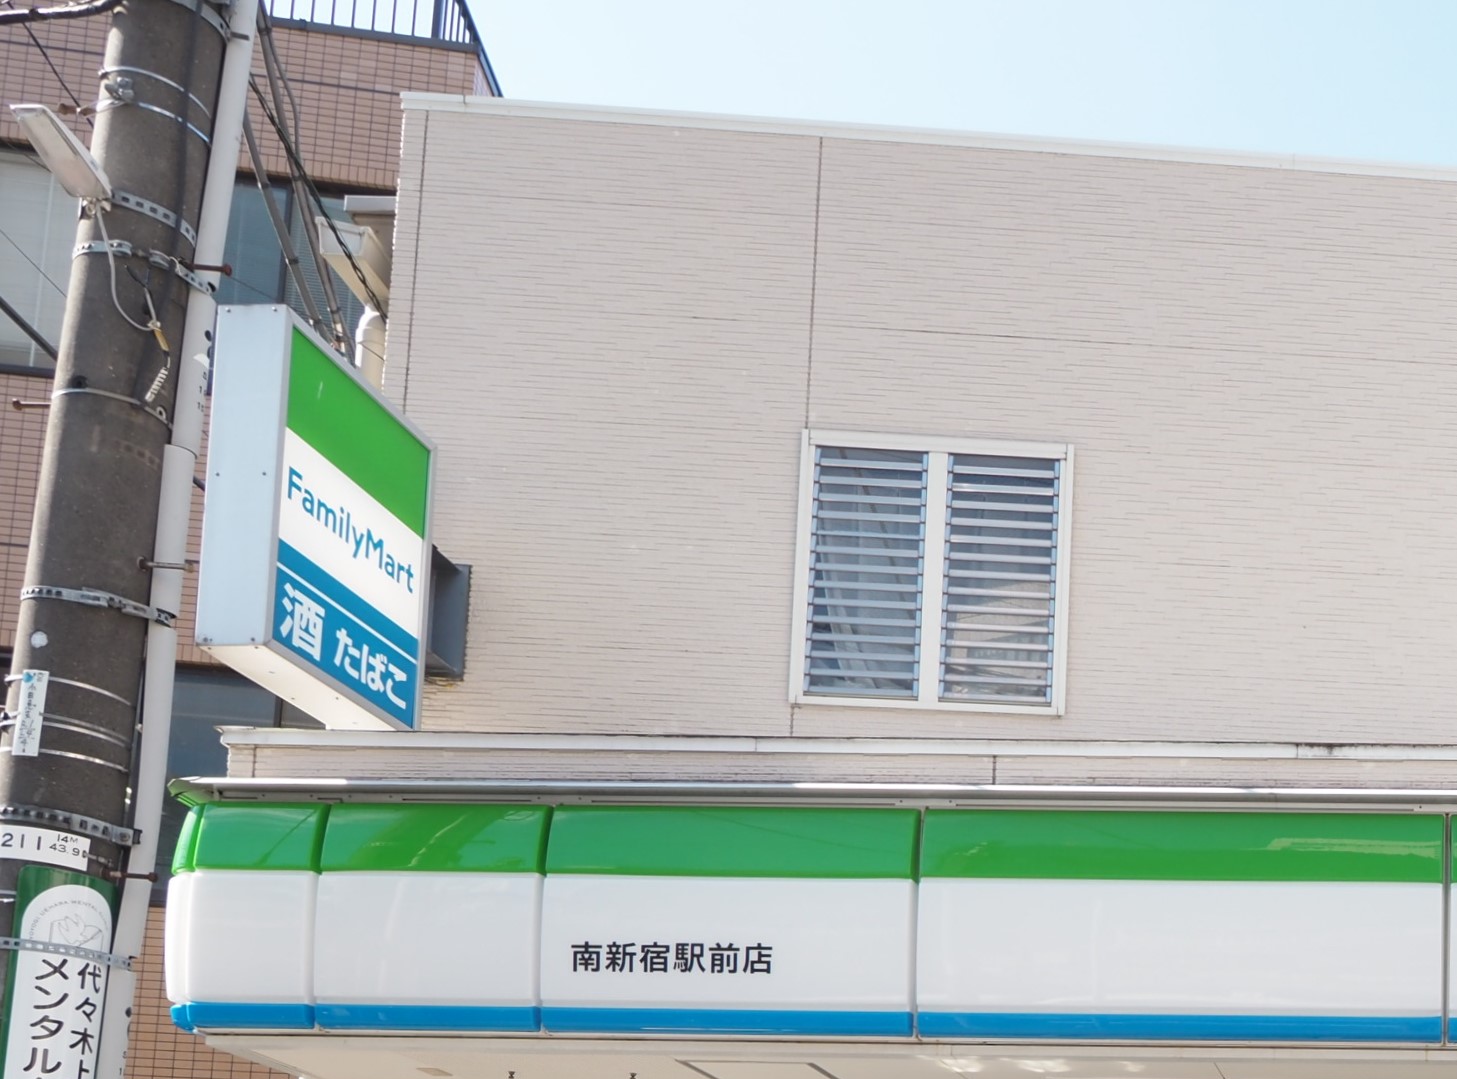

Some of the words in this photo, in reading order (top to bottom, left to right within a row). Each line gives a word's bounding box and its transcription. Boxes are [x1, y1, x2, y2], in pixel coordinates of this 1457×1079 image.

[287, 467, 414, 594] FamilyMart
[280, 582, 325, 662] 酒
[334, 627, 408, 710] たばこ
[49, 843, 80, 856] 43.9
[571, 941, 773, 974] 南新宿駅前店
